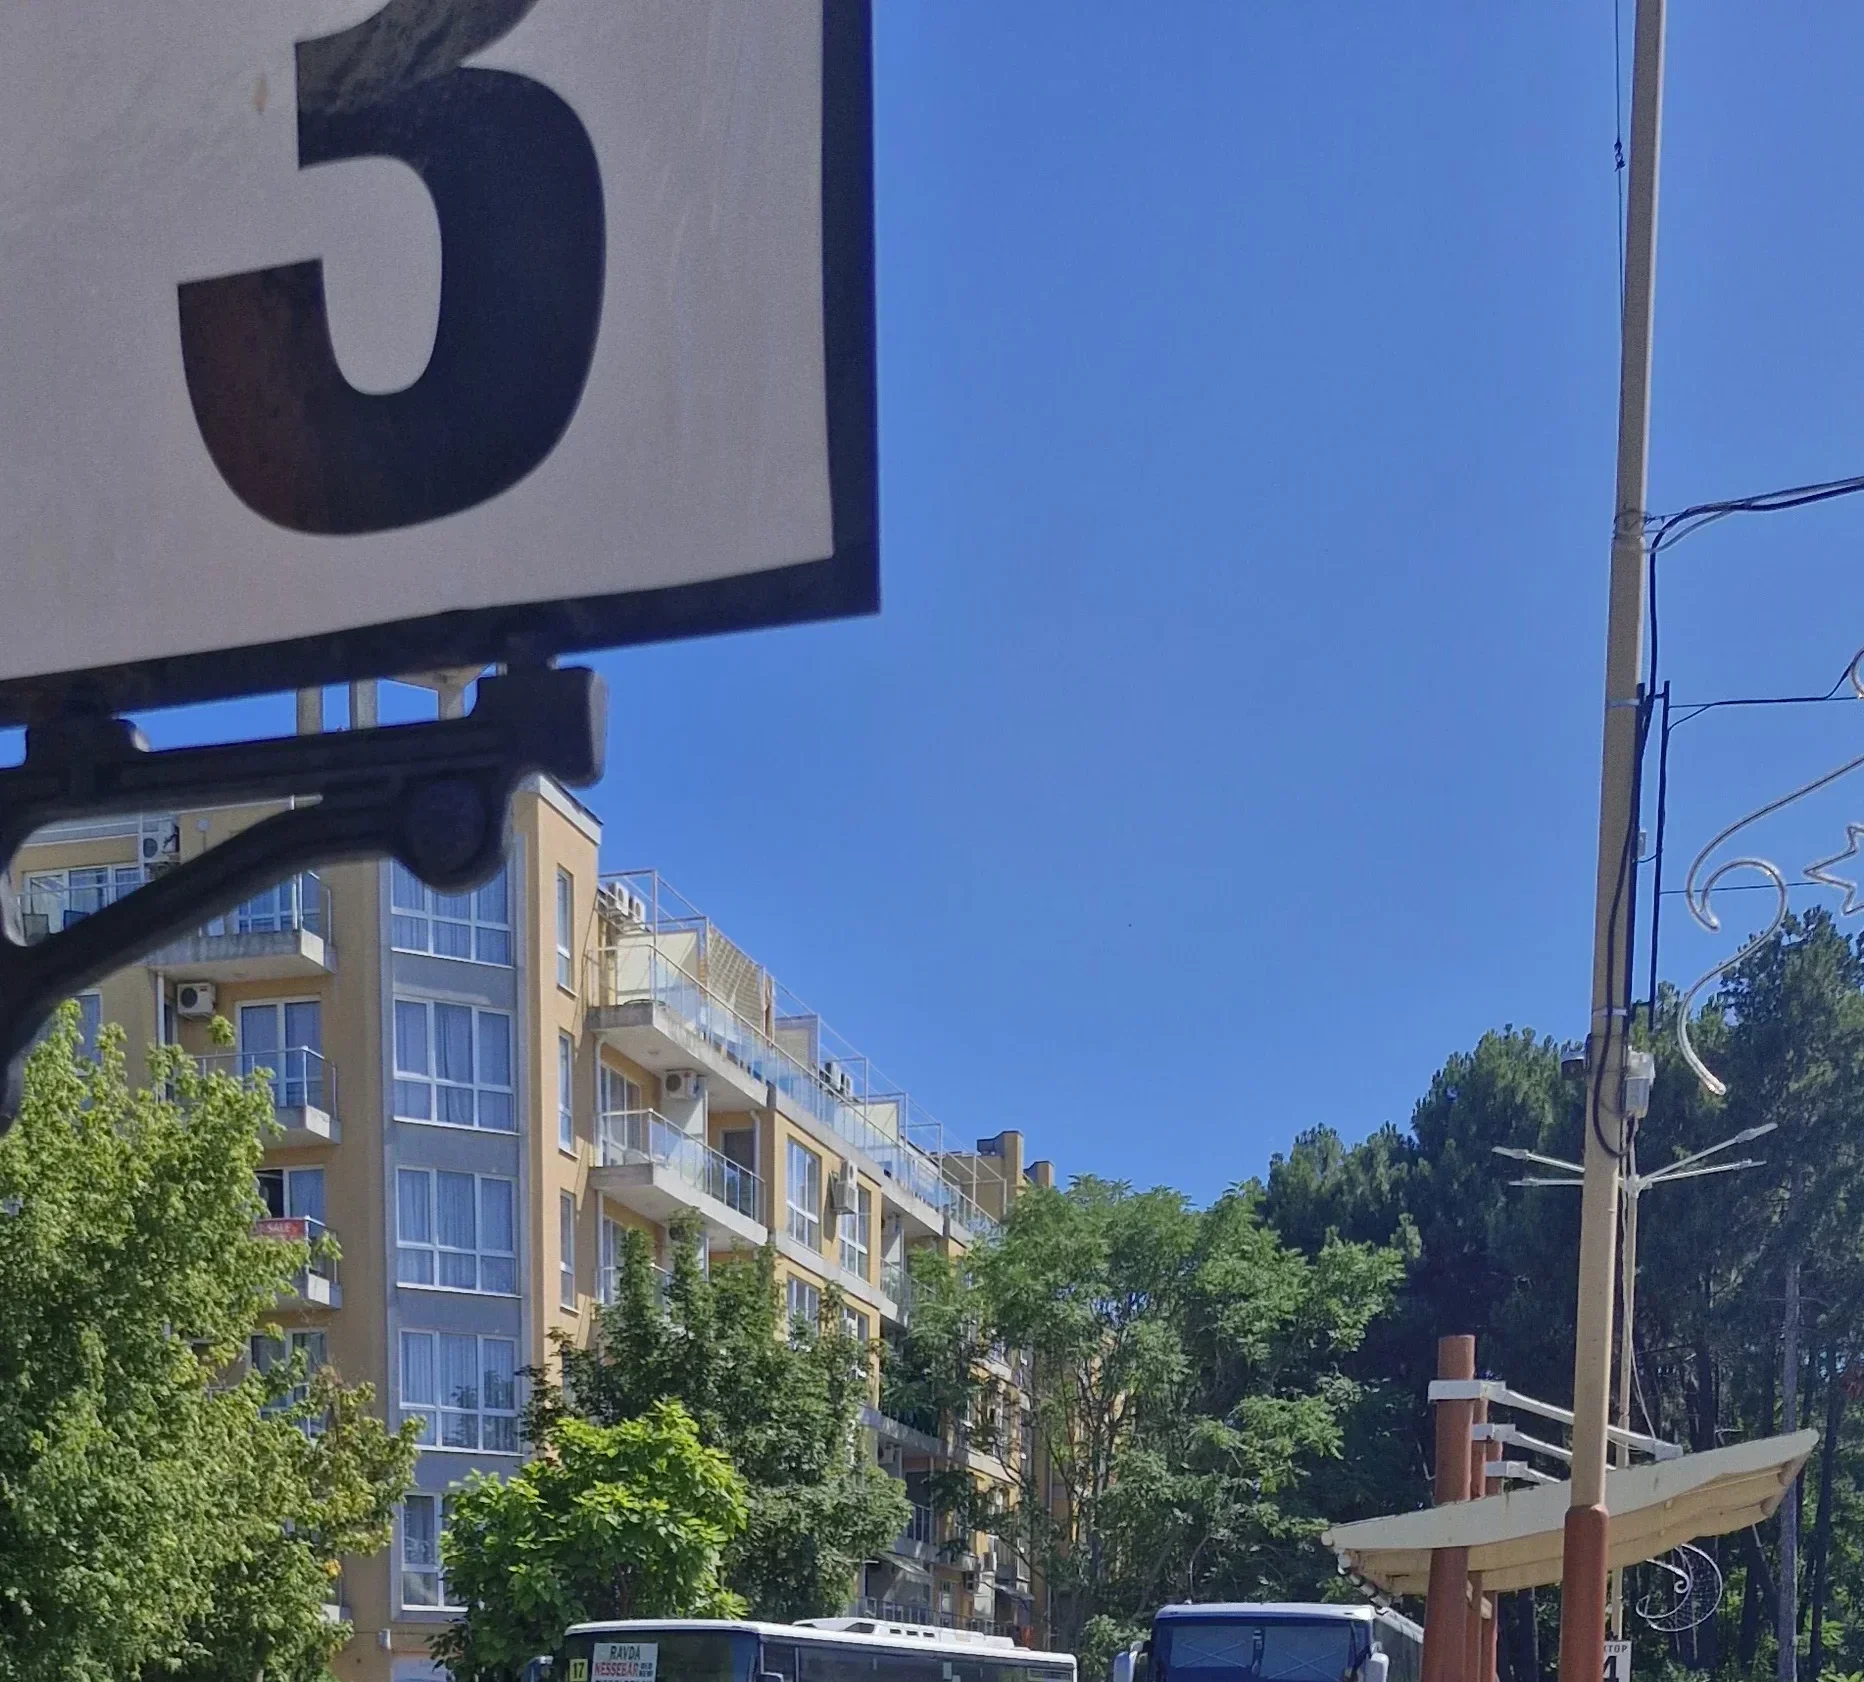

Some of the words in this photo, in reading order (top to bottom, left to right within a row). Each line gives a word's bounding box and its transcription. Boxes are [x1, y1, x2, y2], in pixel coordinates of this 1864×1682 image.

[178, 0, 606, 537] 3
[610, 1645, 641, 1660] RAVDA
[573, 1662, 585, 1679] 17
[595, 1662, 639, 1677] NESSEBAR
